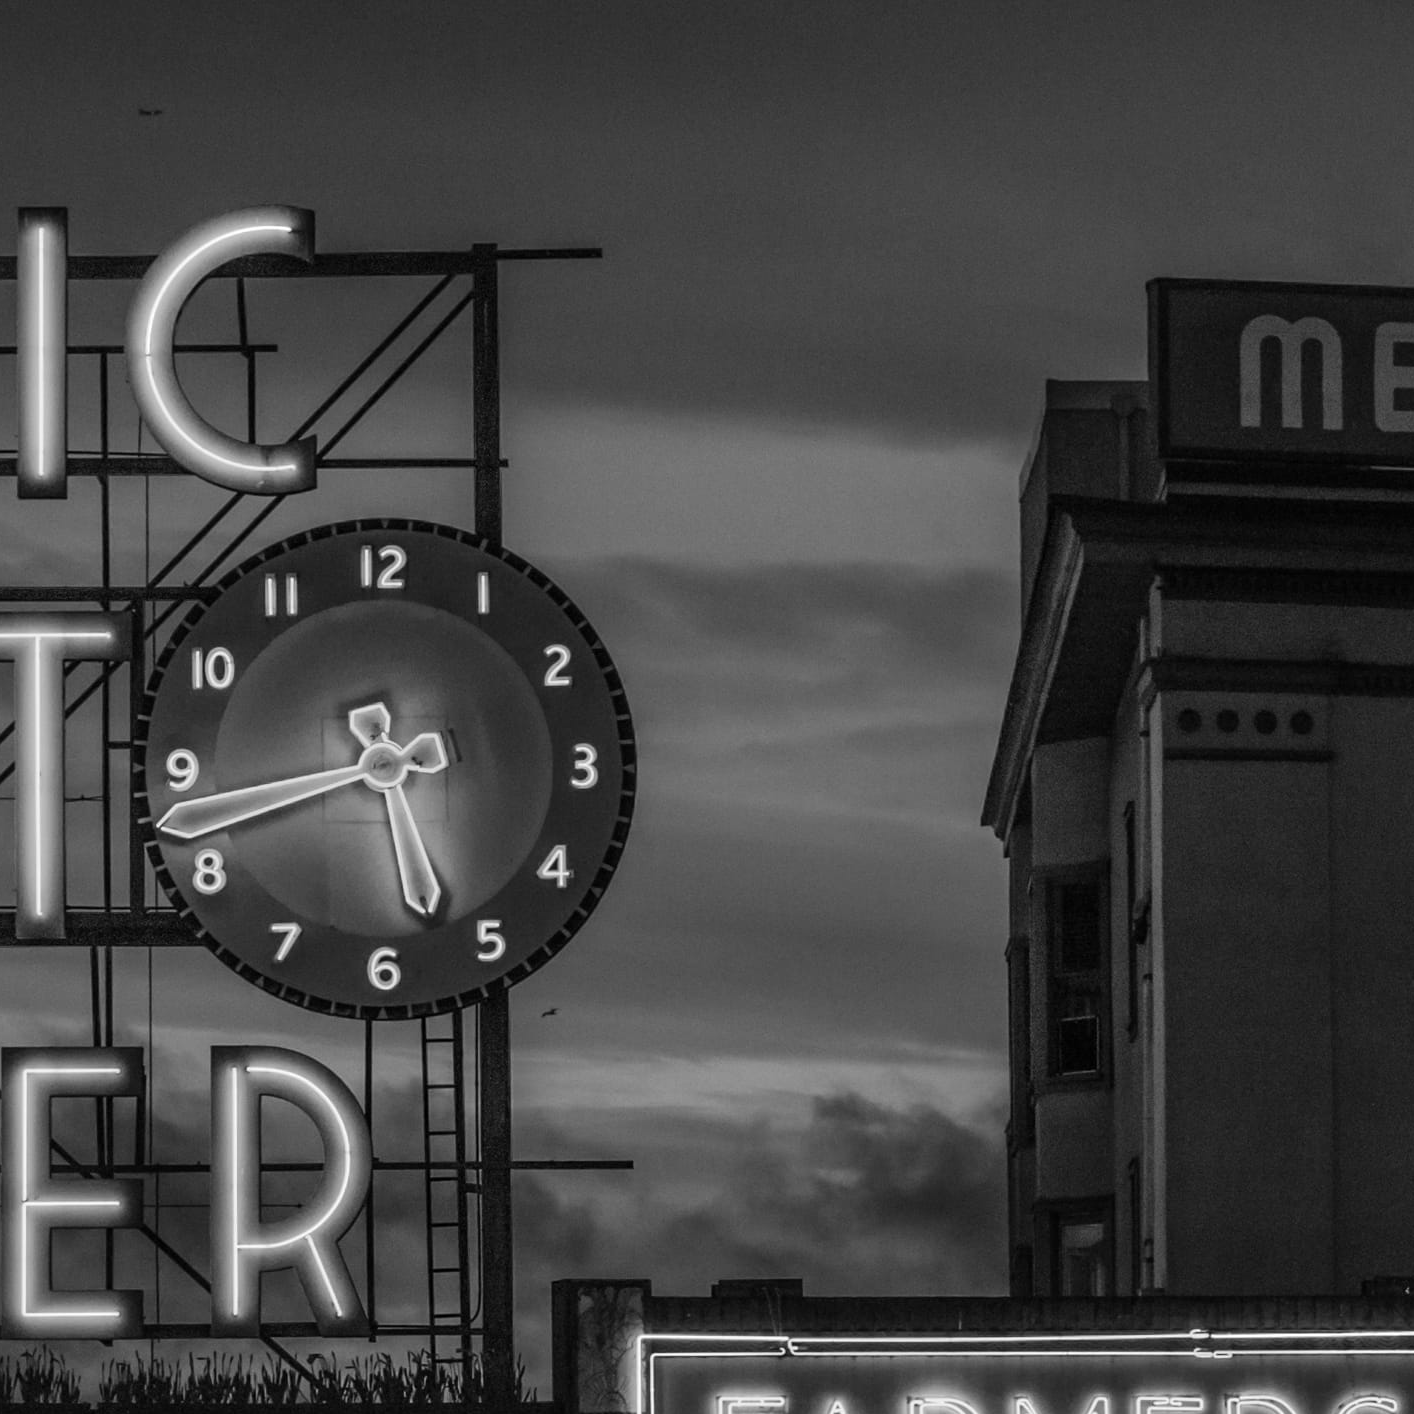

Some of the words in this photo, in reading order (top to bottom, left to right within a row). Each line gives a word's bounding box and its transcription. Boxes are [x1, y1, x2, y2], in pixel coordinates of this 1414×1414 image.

[360, 544, 406, 590] 12
[265, 573, 298, 616] 11
[476, 572, 491, 614] 1
[191, 648, 235, 690] 10
[543, 644, 572, 686] 2
[166, 749, 200, 793] 9
[571, 743, 598, 789] 3
[192, 846, 227, 894] 8
[536, 844, 571, 888] 4
[270, 921, 303, 961] 7
[475, 919, 506, 960] 5
[366, 947, 401, 990] 6
